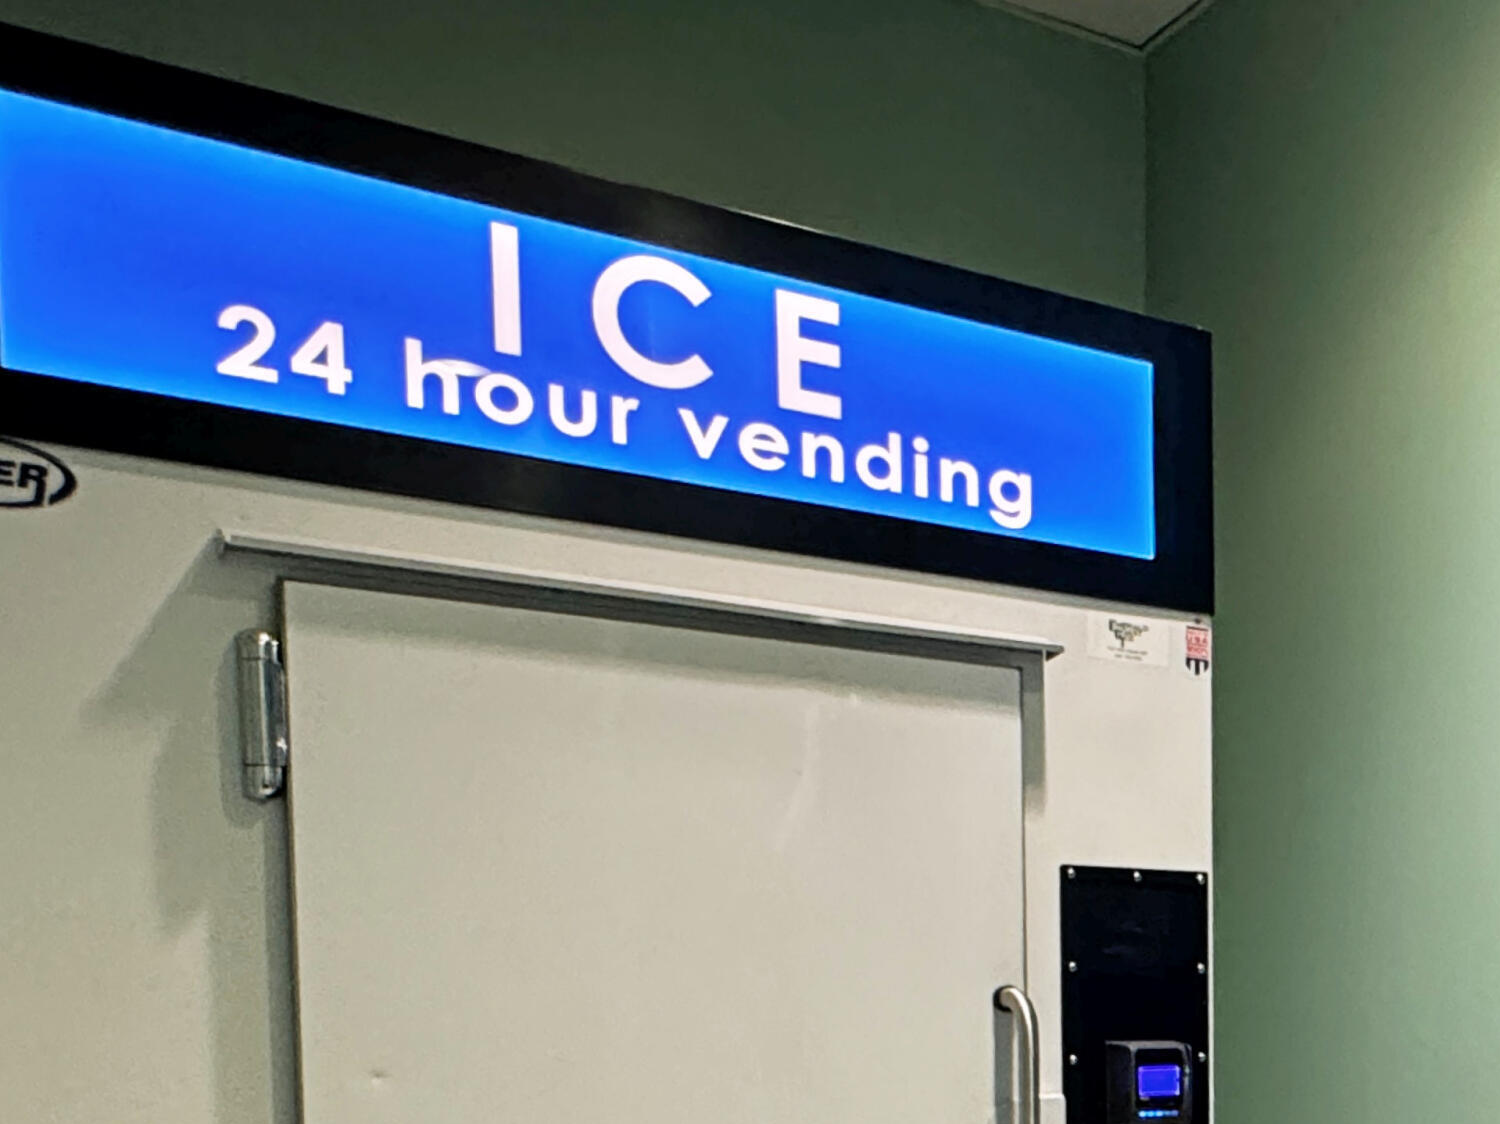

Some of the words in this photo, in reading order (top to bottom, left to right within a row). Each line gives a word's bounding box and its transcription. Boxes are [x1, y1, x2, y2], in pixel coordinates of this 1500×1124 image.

[214, 304, 353, 396] 24
[404, 337, 639, 447] hour
[679, 406, 1036, 531] vending
[488, 221, 842, 420] ICE
